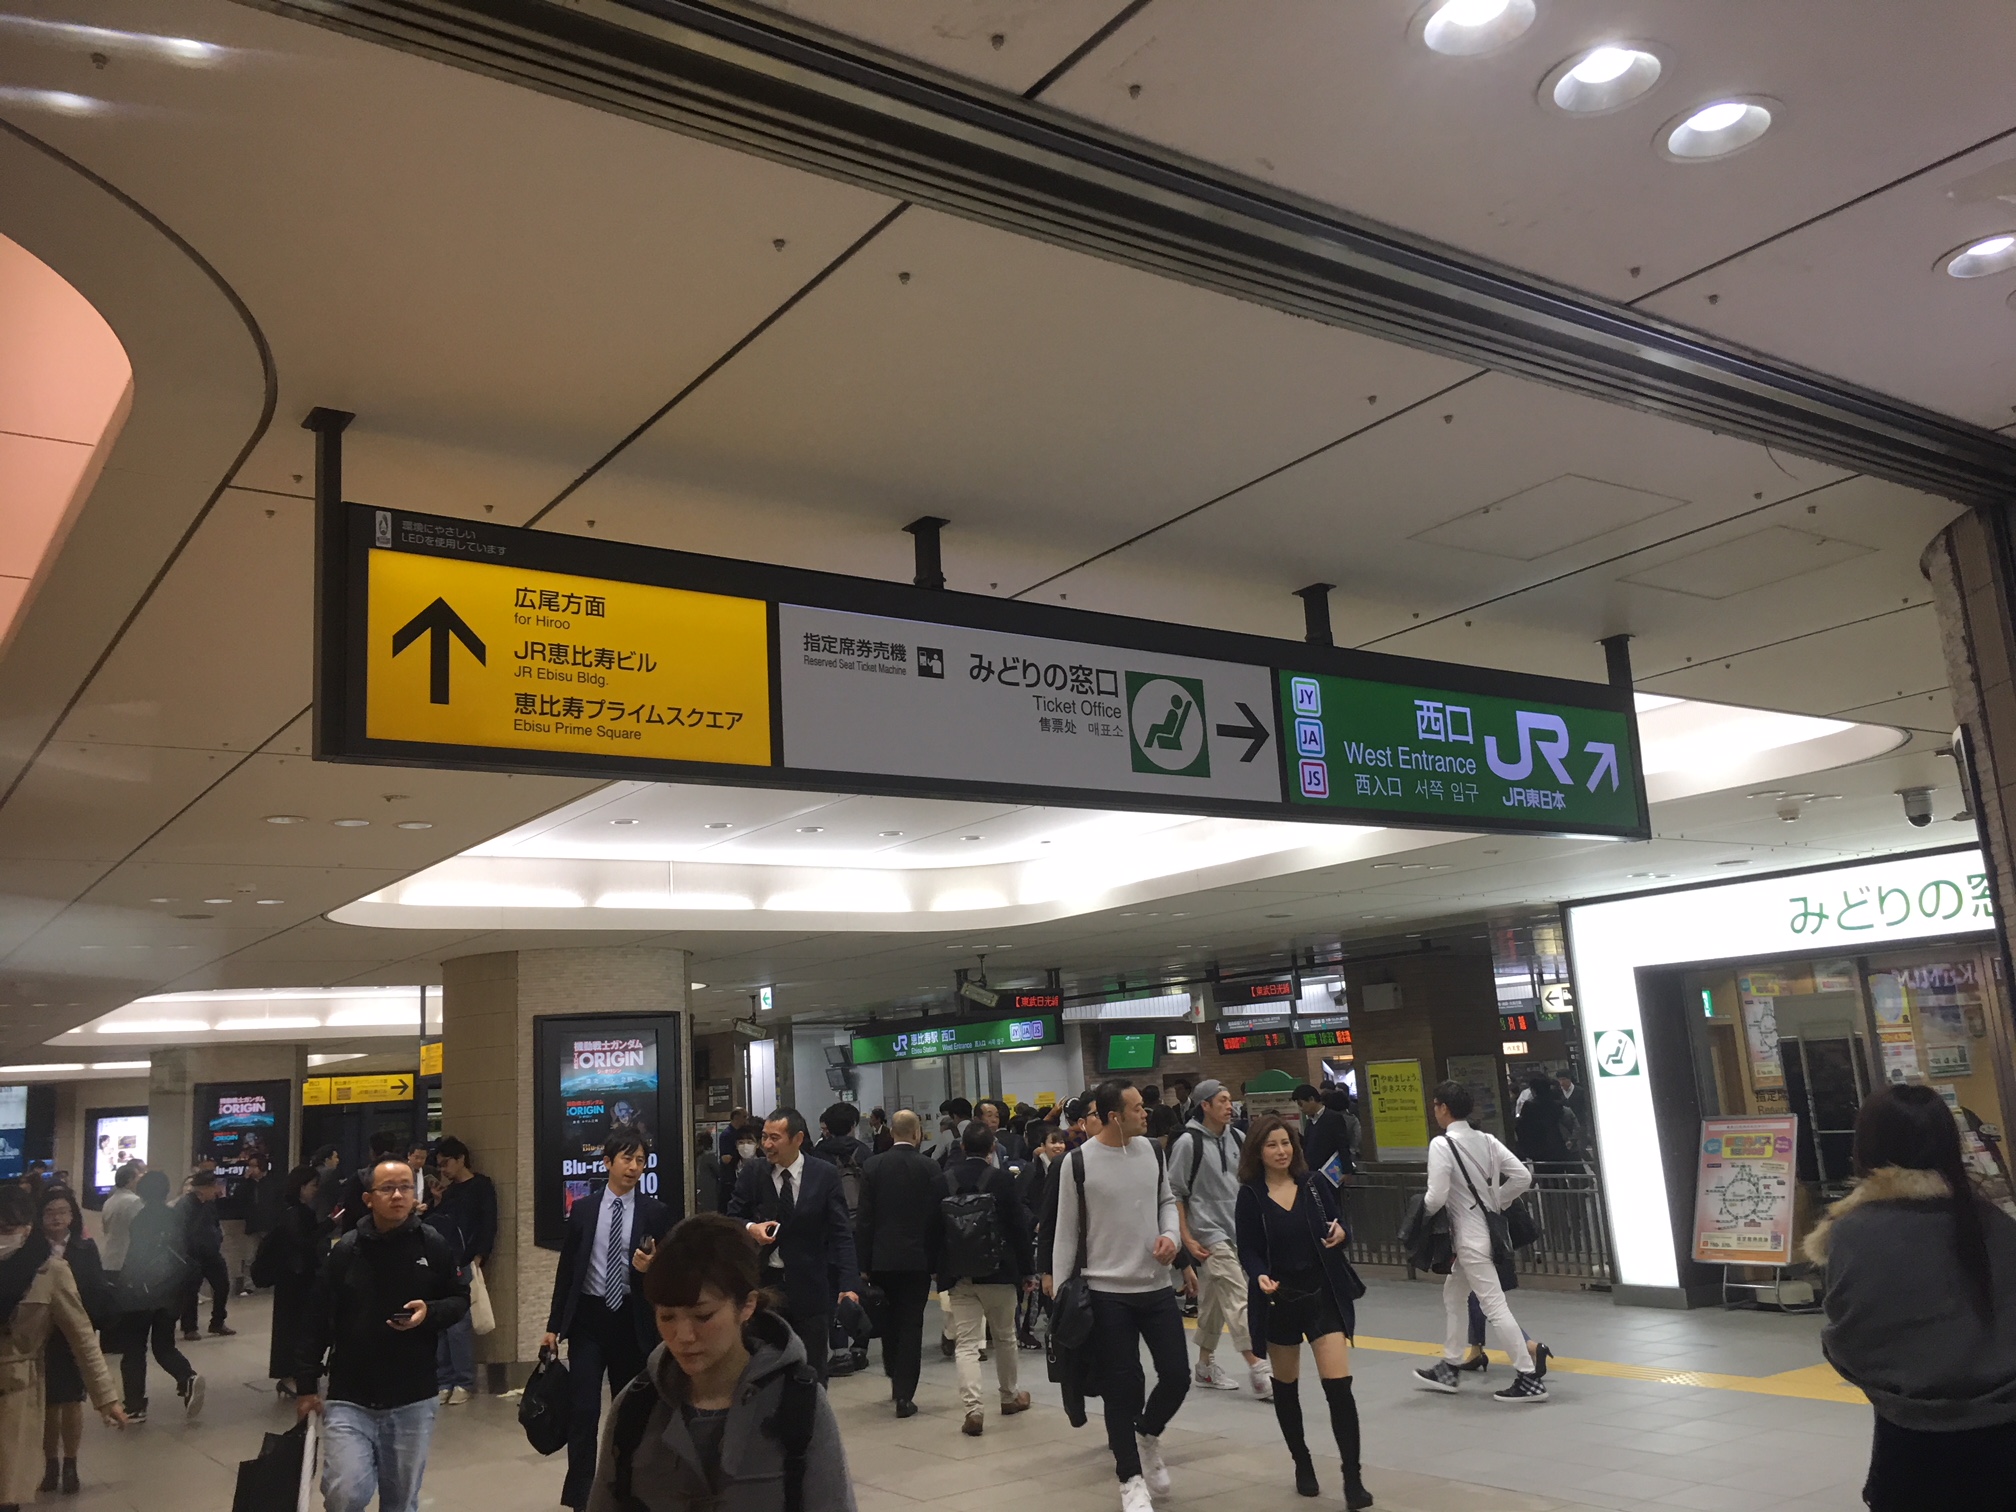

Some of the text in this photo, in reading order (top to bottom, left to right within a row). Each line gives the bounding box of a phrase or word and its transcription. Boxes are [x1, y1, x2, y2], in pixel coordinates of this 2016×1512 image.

[402, 520, 476, 539] 環境にやさしい
[402, 533, 506, 555] LEDを使用しています
[514, 586, 606, 619] 広尾方面
[514, 612, 571, 630] for Hiroo
[514, 640, 658, 673] JR恵比寿ビル
[803, 632, 907, 664] 指定席券売機
[514, 665, 609, 688] JR Ebisu Bldg.
[804, 655, 907, 676] Reserved Seat Ticket Machine
[969, 653, 1119, 699] みどりの窓口
[1032, 695, 1122, 719] Ticket Office
[1299, 689, 1314, 705] JY
[514, 692, 744, 731] 恵比寿プライムスクエア
[1414, 700, 1474, 744] 西口
[514, 719, 642, 741] Ebisu Prime Square
[1039, 717, 1077, 735] 售票处
[1088, 721, 1124, 738] 매표소
[1302, 730, 1319, 746] JA
[1484, 710, 1574, 785] JR
[1344, 741, 1477, 775] West Entrance
[1307, 771, 1321, 786] JS
[1354, 774, 1402, 797] 西入口
[1415, 779, 1479, 803] 서쪽 입구
[1503, 786, 1567, 810] JR東日本
[1294, 1021, 1299, 1030] 4
[893, 1034, 908, 1051] JR
[580, 1051, 644, 1069] ORIGIN
[223, 1103, 265, 1114] ORIGIN
[570, 1106, 604, 1115] ORIGIN
[562, 1159, 607, 1176] Blu-ra
